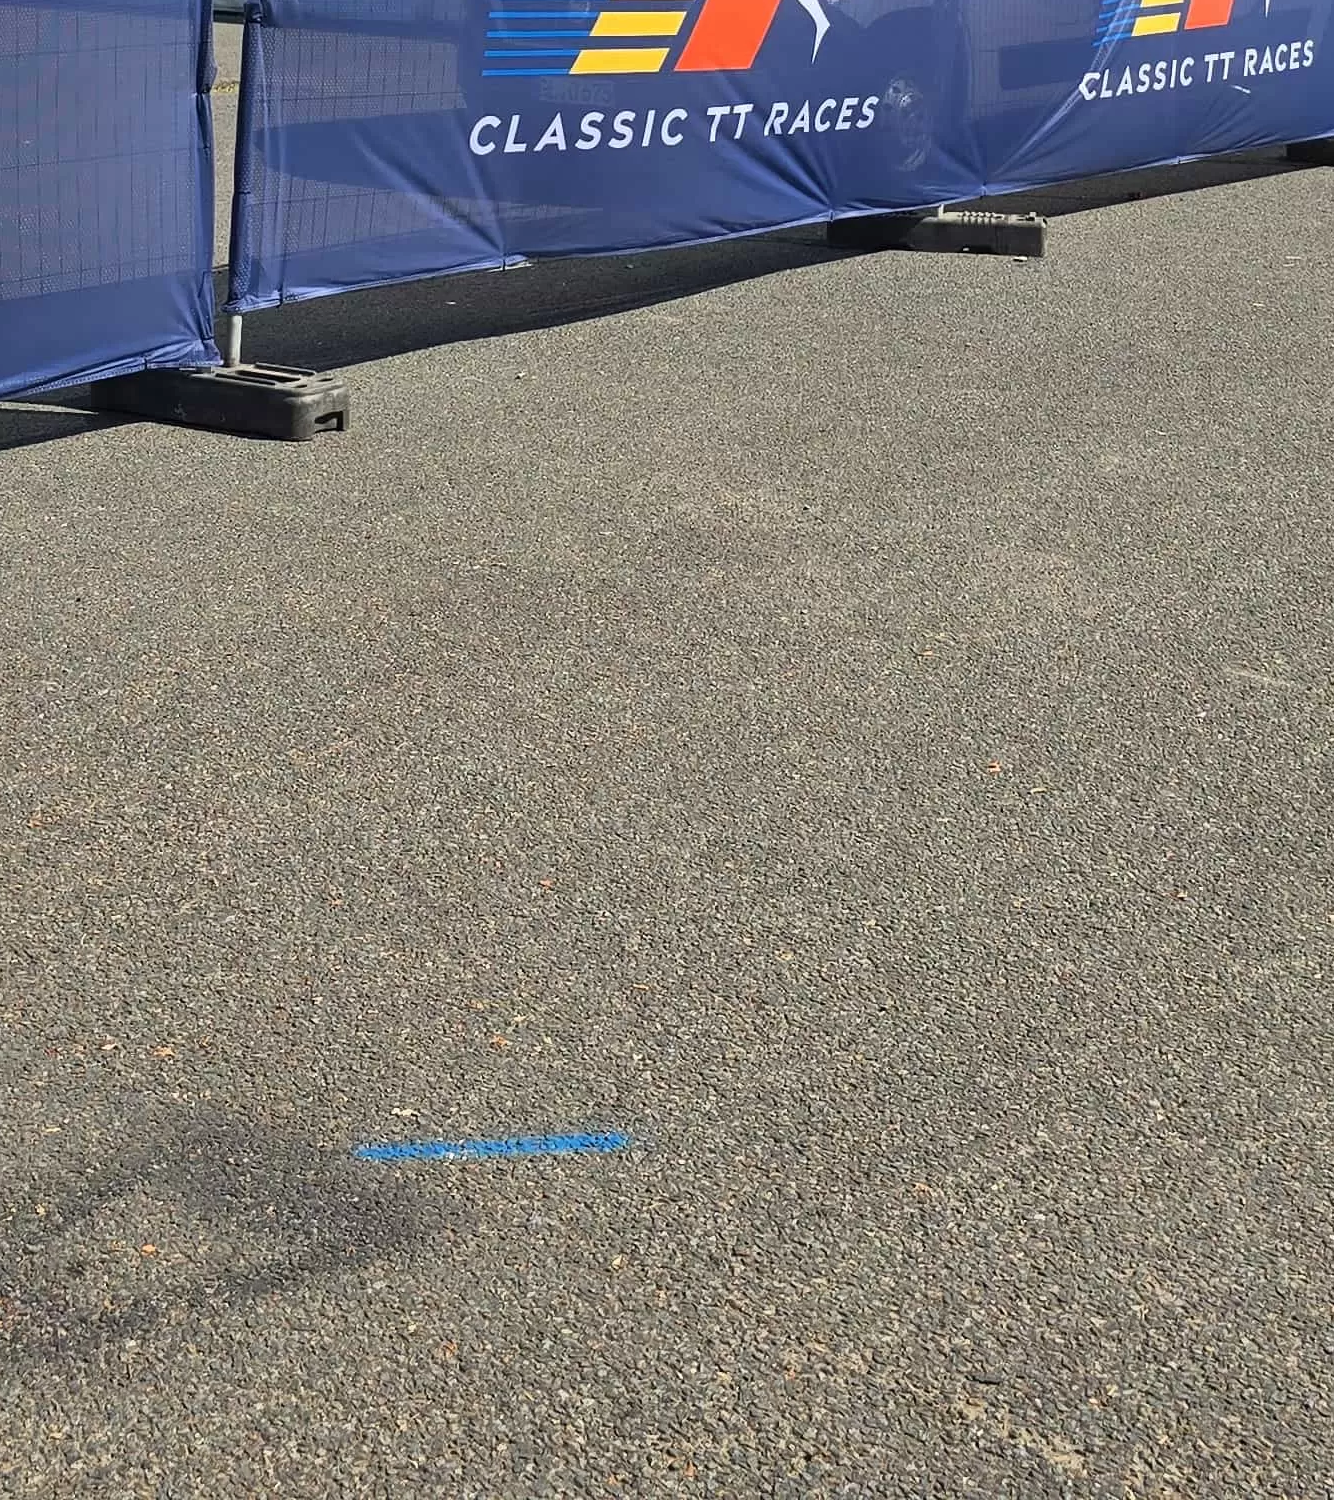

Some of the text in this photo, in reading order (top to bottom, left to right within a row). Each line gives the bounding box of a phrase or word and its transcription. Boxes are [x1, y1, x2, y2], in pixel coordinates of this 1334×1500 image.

[1078, 39, 1314, 101] CLASSIC TT RACES
[469, 96, 879, 156] CLASSIC TT RACES
